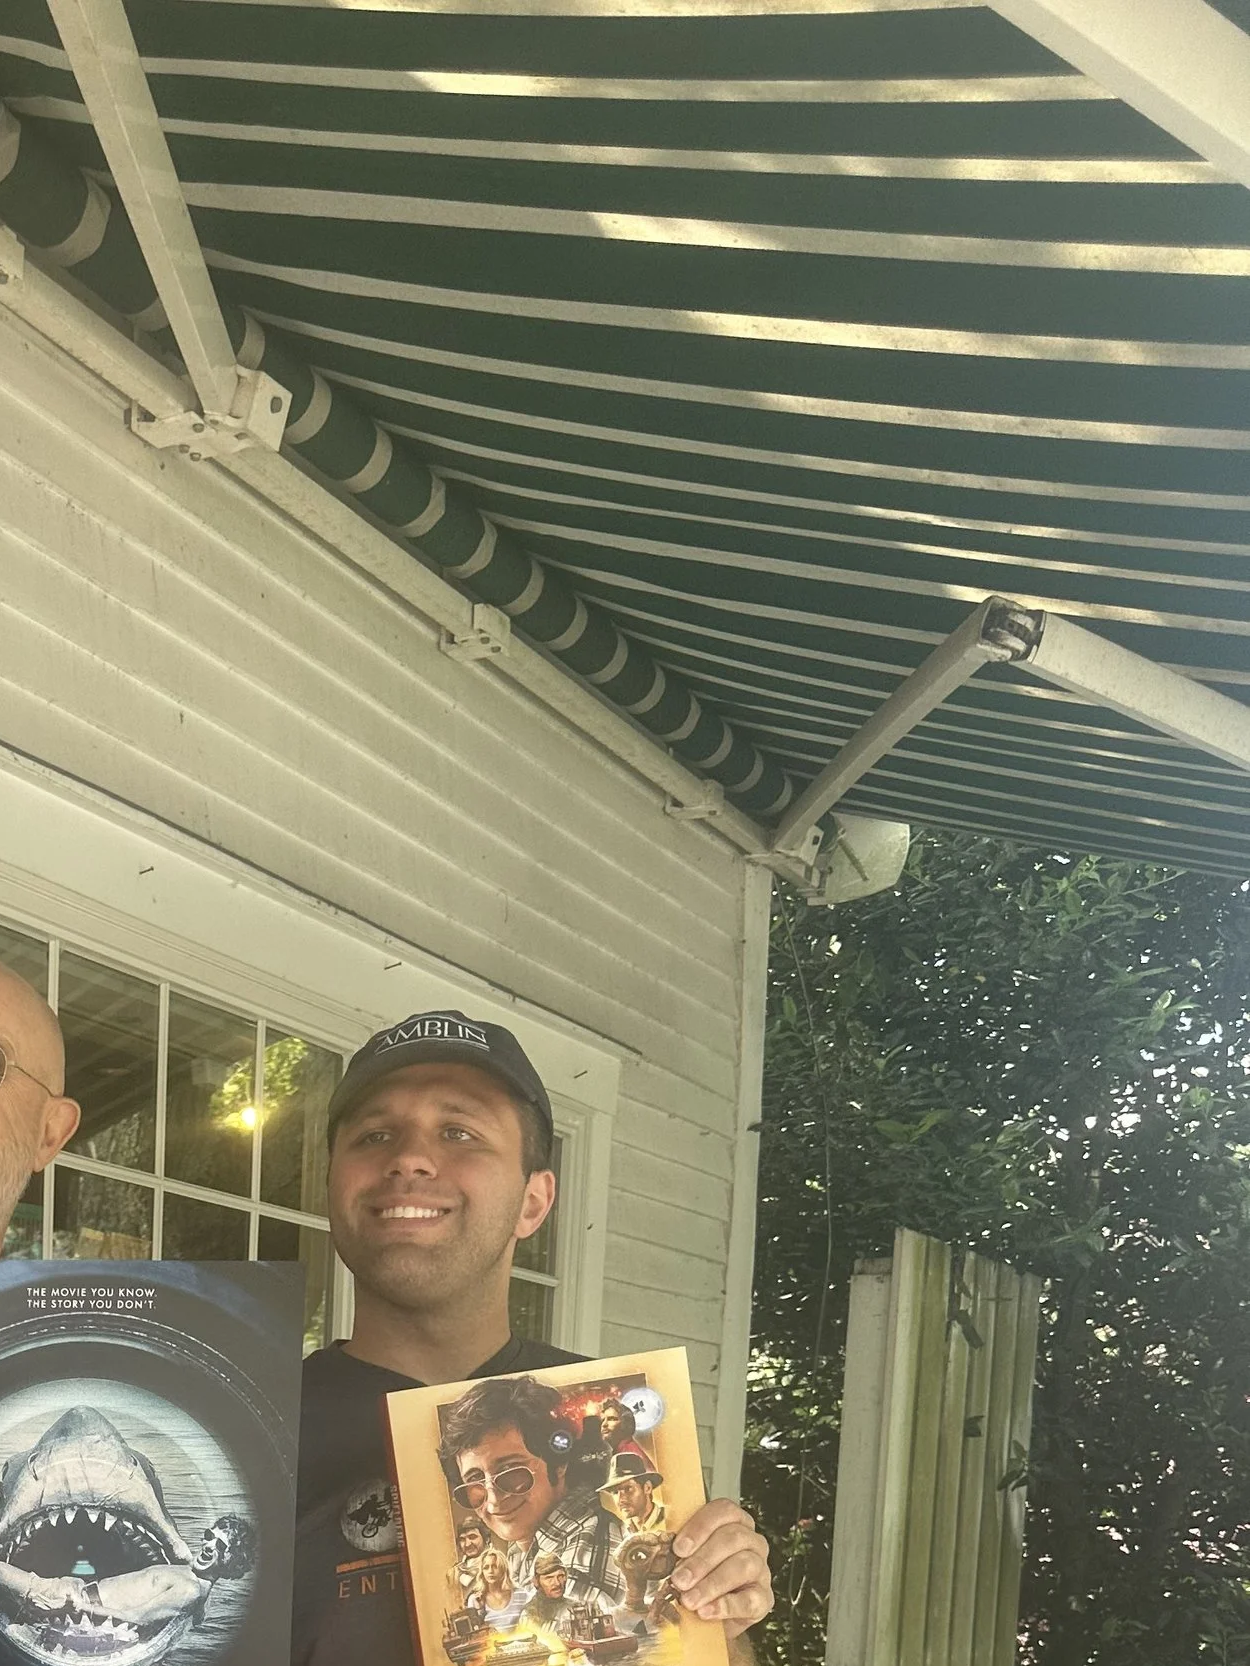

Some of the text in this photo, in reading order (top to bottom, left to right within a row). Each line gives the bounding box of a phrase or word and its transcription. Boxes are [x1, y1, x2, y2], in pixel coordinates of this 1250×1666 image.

[375, 1019, 488, 1052] AMBLIN
[27, 1287, 158, 1298] THE MOVIE YOU KNOW.
[27, 1299, 156, 1310] THE STORY YOU DON'T.
